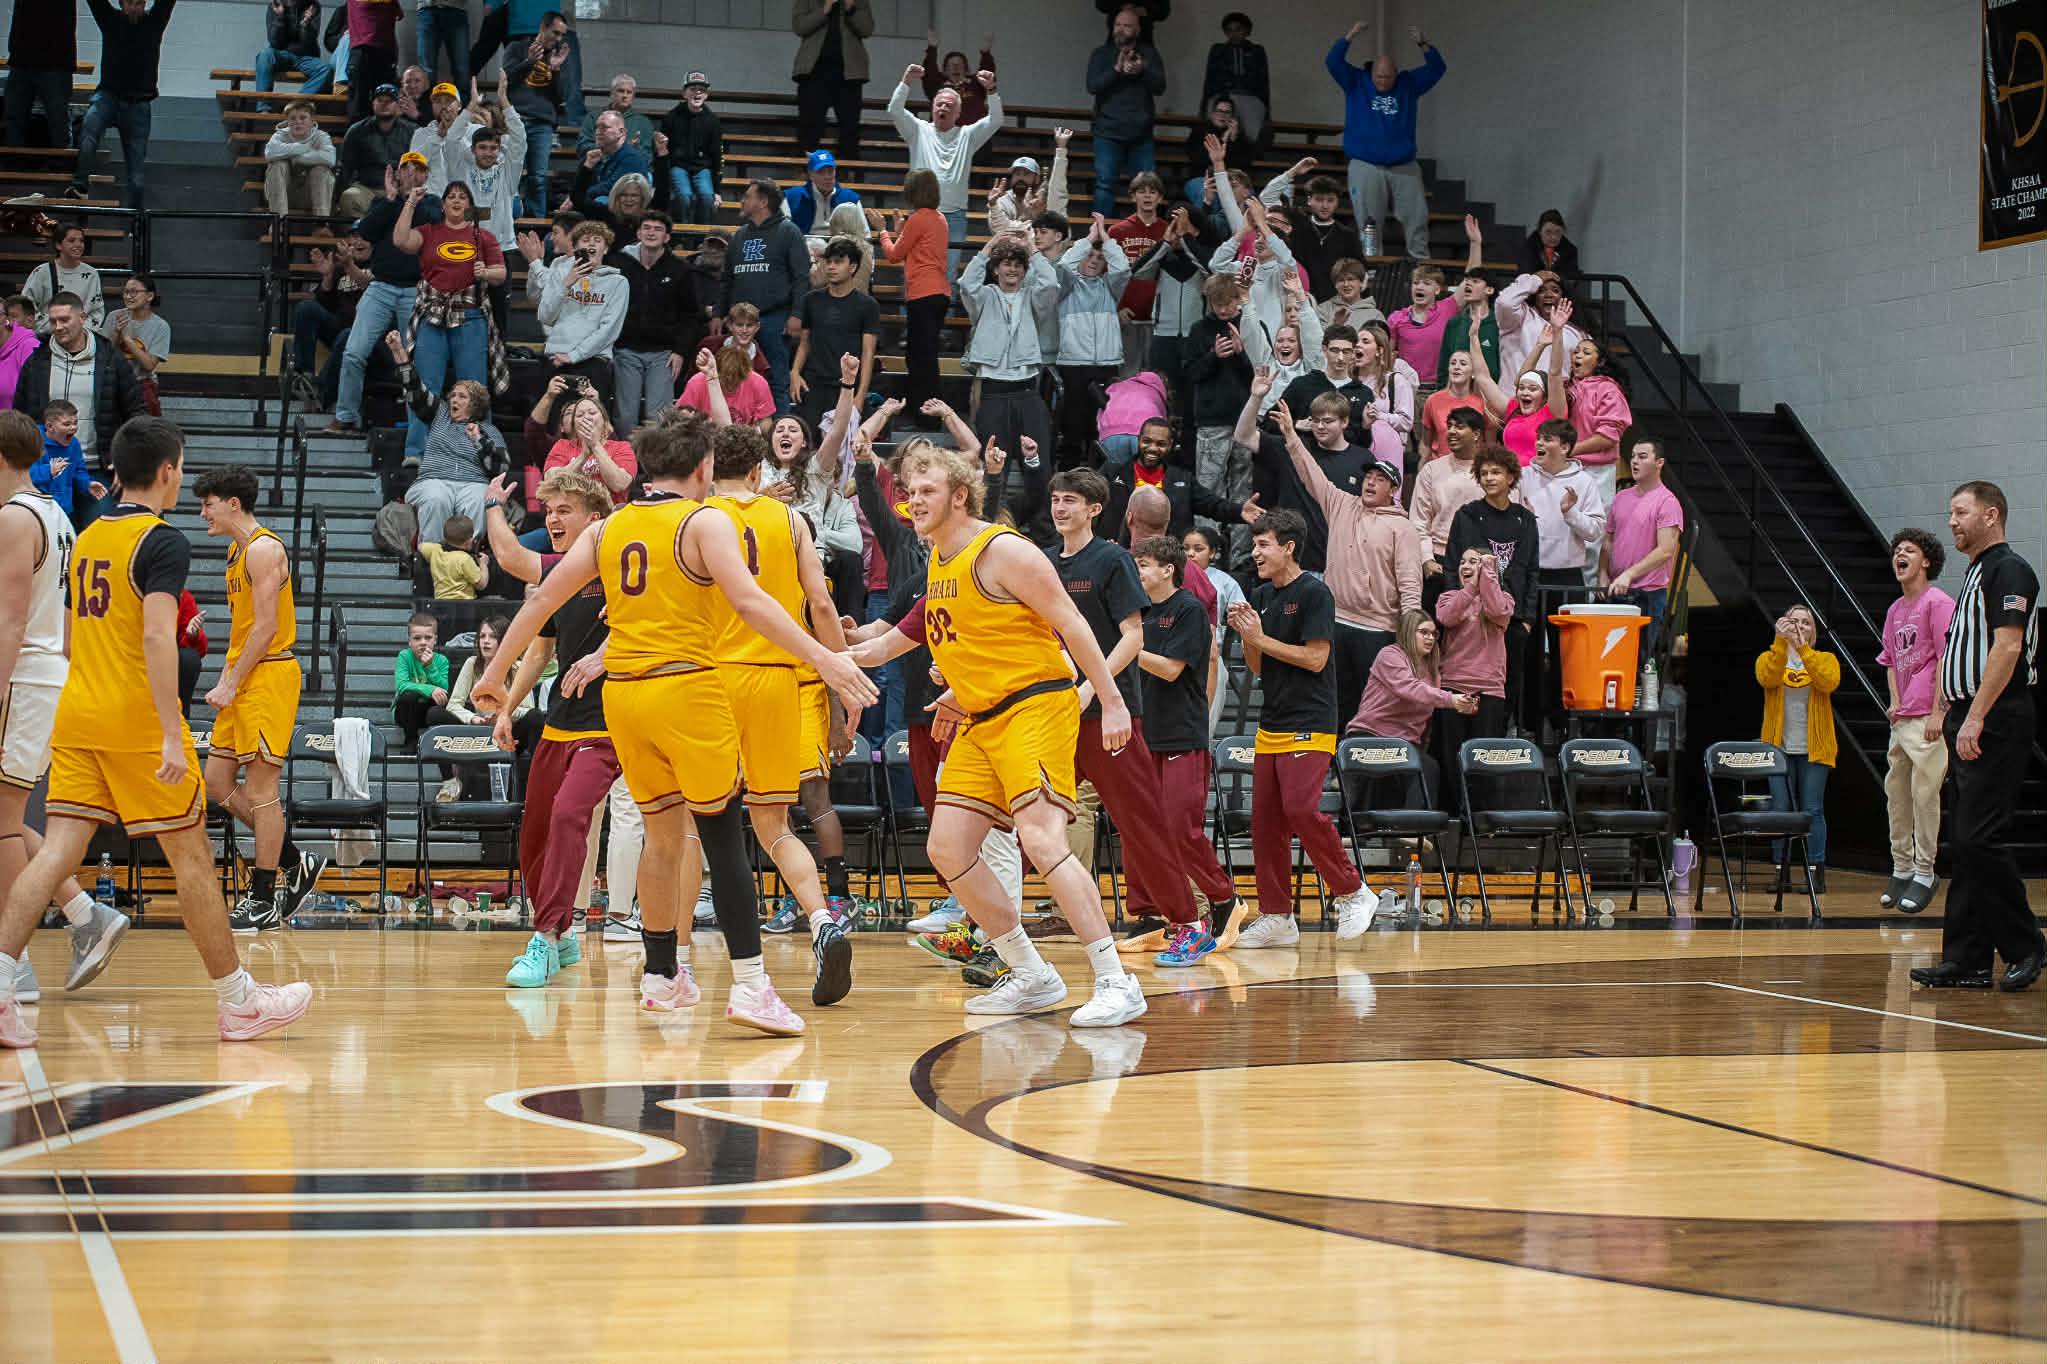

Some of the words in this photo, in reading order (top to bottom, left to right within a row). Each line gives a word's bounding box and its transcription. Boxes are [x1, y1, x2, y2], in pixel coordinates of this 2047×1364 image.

[2011, 173, 2042, 191] KHSAA
[1991, 194, 2017, 211] STATE
[2017, 206, 2036, 220] 2022
[437, 241, 476, 262] G
[734, 262, 770, 274] KENTUCKY
[620, 541, 648, 597] 0
[76, 557, 112, 618] 15
[926, 607, 958, 647] 32
[433, 736, 500, 752] REBEL
[1349, 747, 1408, 764] REBELS
[1472, 748, 1532, 765] REBELS
[1571, 750, 1631, 765] REBELS
[1718, 751, 1776, 768] REBELS
